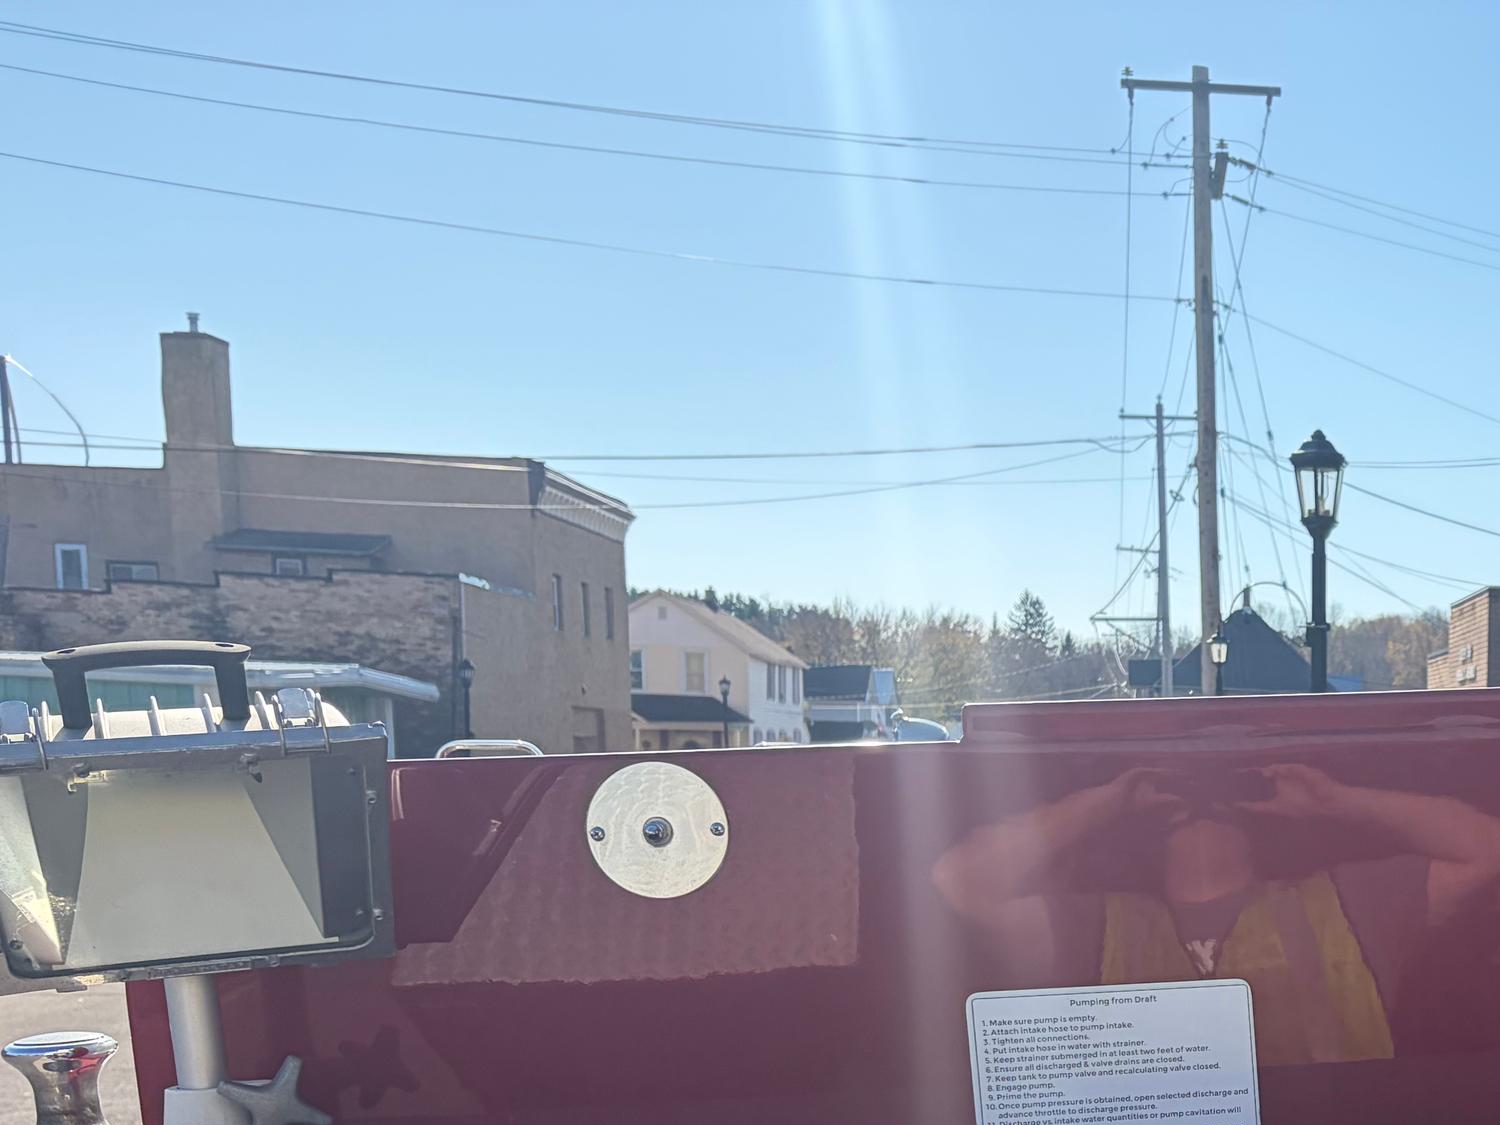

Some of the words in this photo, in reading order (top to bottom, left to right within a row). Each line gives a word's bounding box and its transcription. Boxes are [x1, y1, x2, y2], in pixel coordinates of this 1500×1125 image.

[1070, 999, 1110, 1007] Pumping
[1135, 995, 1157, 1003] Draft
[1034, 1017, 1058, 1025] pump
[1068, 1015, 1096, 1023] empty.
[991, 1028, 1019, 1036] Attach
[1021, 1026, 1047, 1034] intake
[1080, 1024, 1105, 1032] pump
[1106, 1022, 1134, 1030] intake.
[992, 1038, 1024, 1046] Tighten
[1026, 1036, 1036, 1044] all
[1037, 1034, 1090, 1042] connections.
